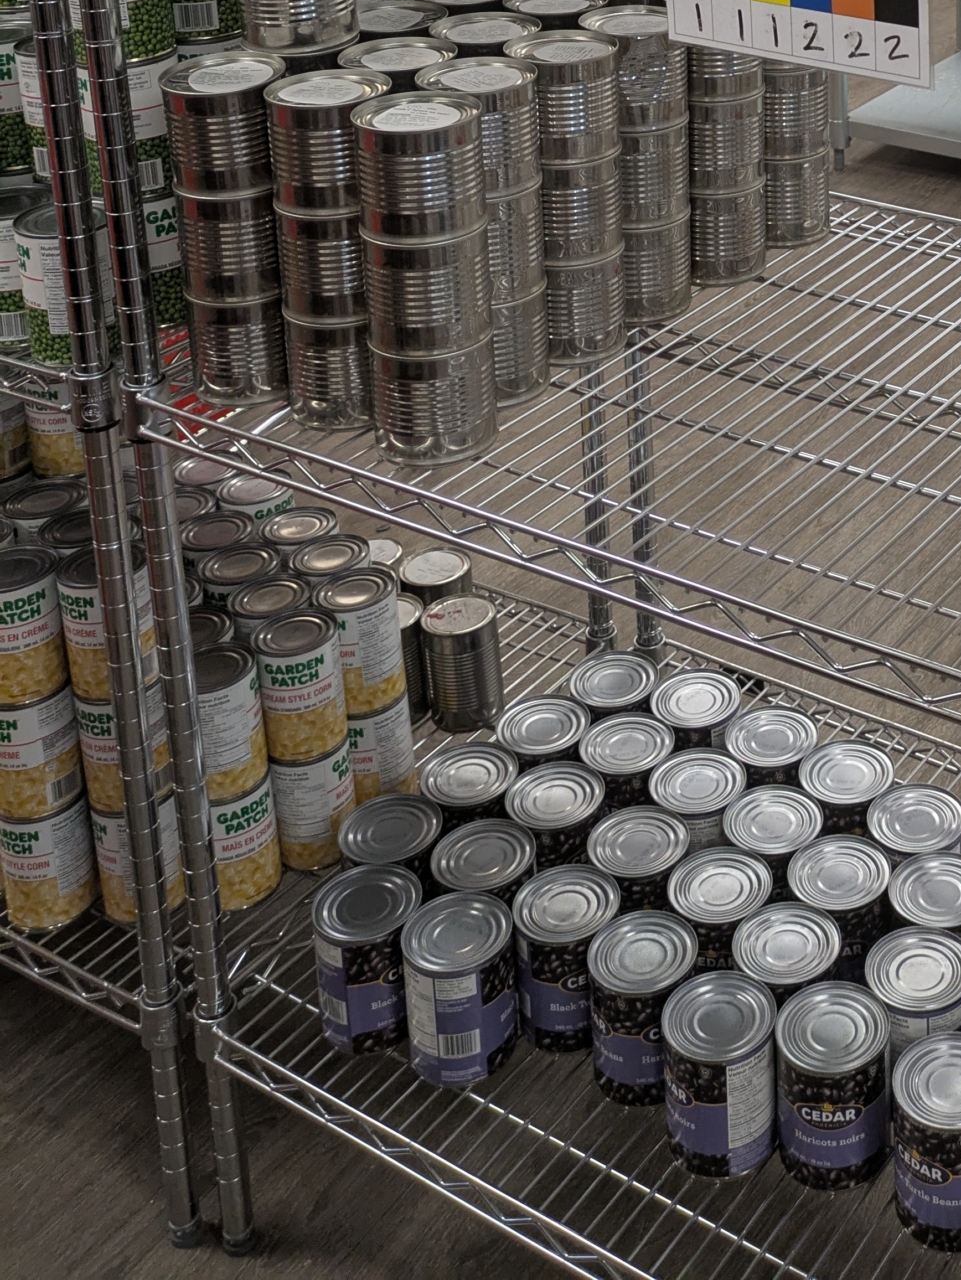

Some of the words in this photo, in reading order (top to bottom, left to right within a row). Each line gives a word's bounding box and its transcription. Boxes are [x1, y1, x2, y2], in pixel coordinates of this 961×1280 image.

[696, 3, 702, 32] 1
[738, 9, 744, 41] 1
[772, 14, 778, 47] 1
[803, 22, 824, 50] 2
[844, 31, 870, 58] 2
[884, 35, 909, 60] 2
[8, 634, 18, 643] EN
[22, 622, 50, 640] CRÈME
[73, 628, 97, 638] CRÈME
[264, 654, 324, 676] GARDEN
[270, 670, 320, 688] PATCH
[264, 692, 286, 704] CREAM
[288, 690, 312, 704] STYLE
[314, 682, 332, 697] CORN
[216, 790, 270, 824] GARDEN
[225, 805, 269, 836] PATCH
[244, 836, 255, 847] EN
[27, 861, 50, 871] CORN
[371, 997, 398, 1011] Black
[550, 1001, 576, 1012] Black
[801, 1107, 856, 1122] CEDAR
[795, 1130, 837, 1147] Haricots
[839, 1131, 865, 1144] noirs
[898, 1148, 942, 1182] CEDAR
